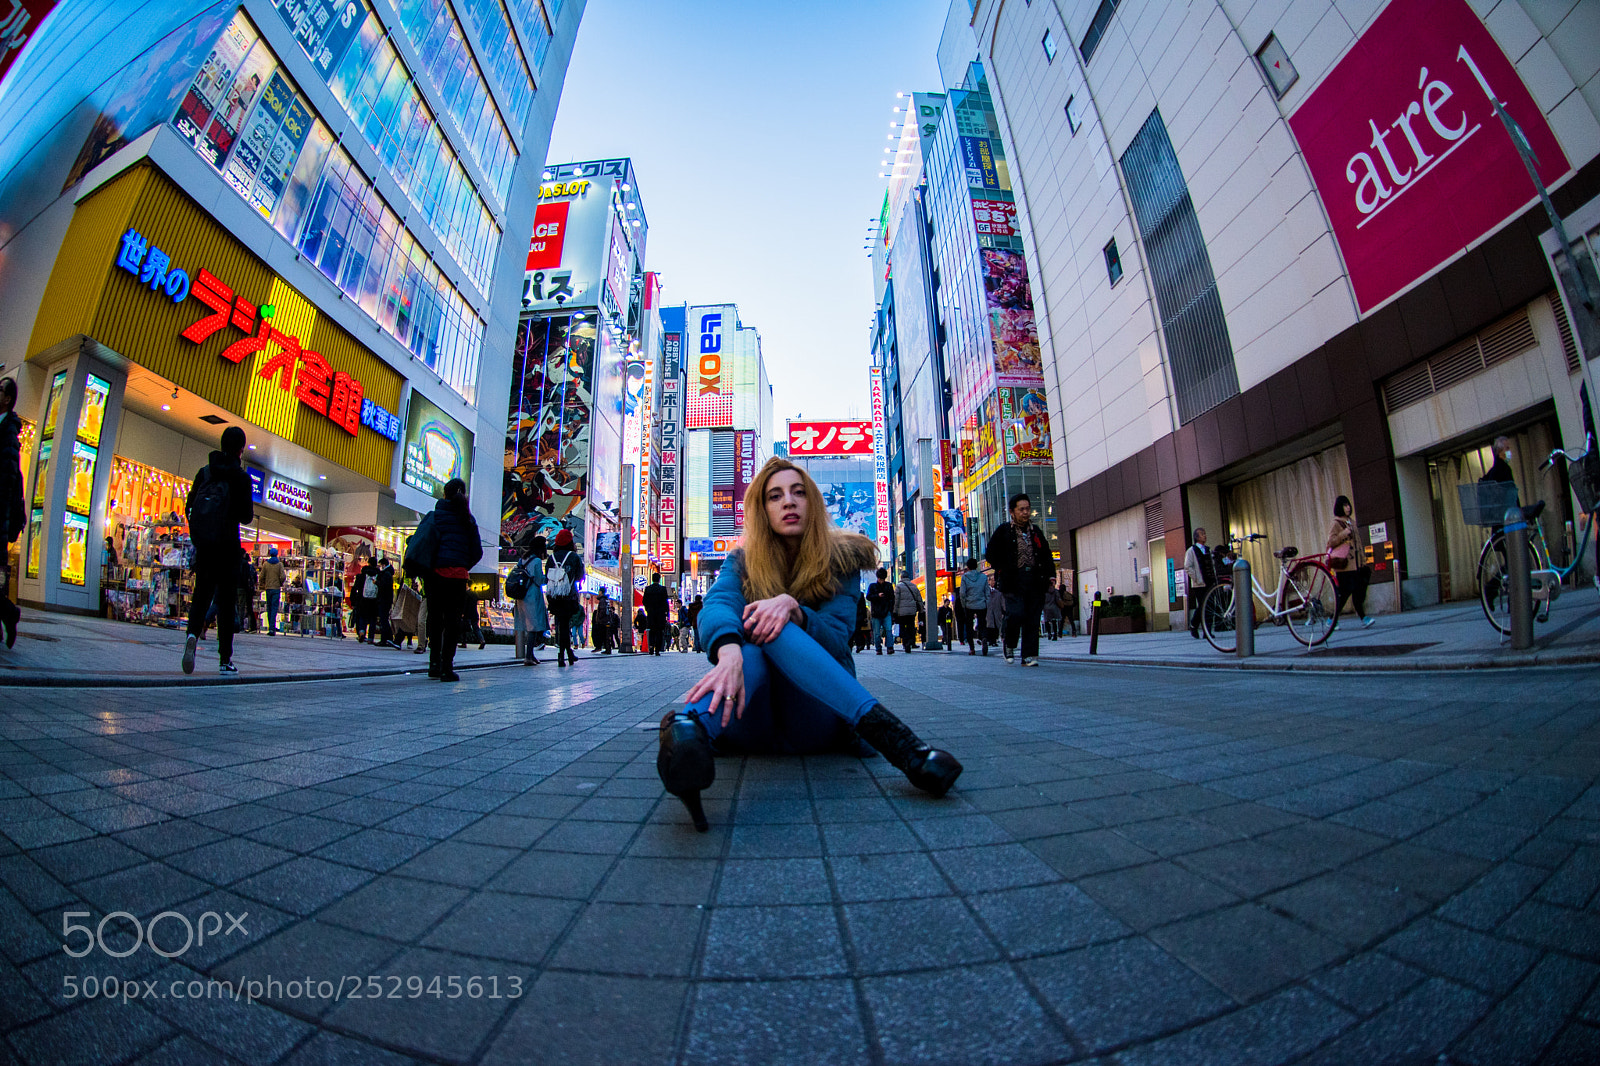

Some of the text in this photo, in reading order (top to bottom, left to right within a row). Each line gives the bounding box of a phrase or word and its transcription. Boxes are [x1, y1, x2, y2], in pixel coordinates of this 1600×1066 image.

[1346, 44, 1508, 214] atré 1
[969, 176, 982, 184] 7F
[531, 222, 559, 239] CE
[974, 209, 1006, 223] ぽち
[978, 224, 990, 232] 6F
[116, 227, 401, 442] 世界の ラジオ会館 秋葉原
[664, 334, 673, 378] PARADISE
[872, 380, 883, 428] TAKARADA
[741, 433, 754, 484] Duty Free
[267, 489, 313, 514] RADIOKAIKAN
[272, 480, 311, 502] AKIHABARA
[932, 468, 945, 552] GAMERS
